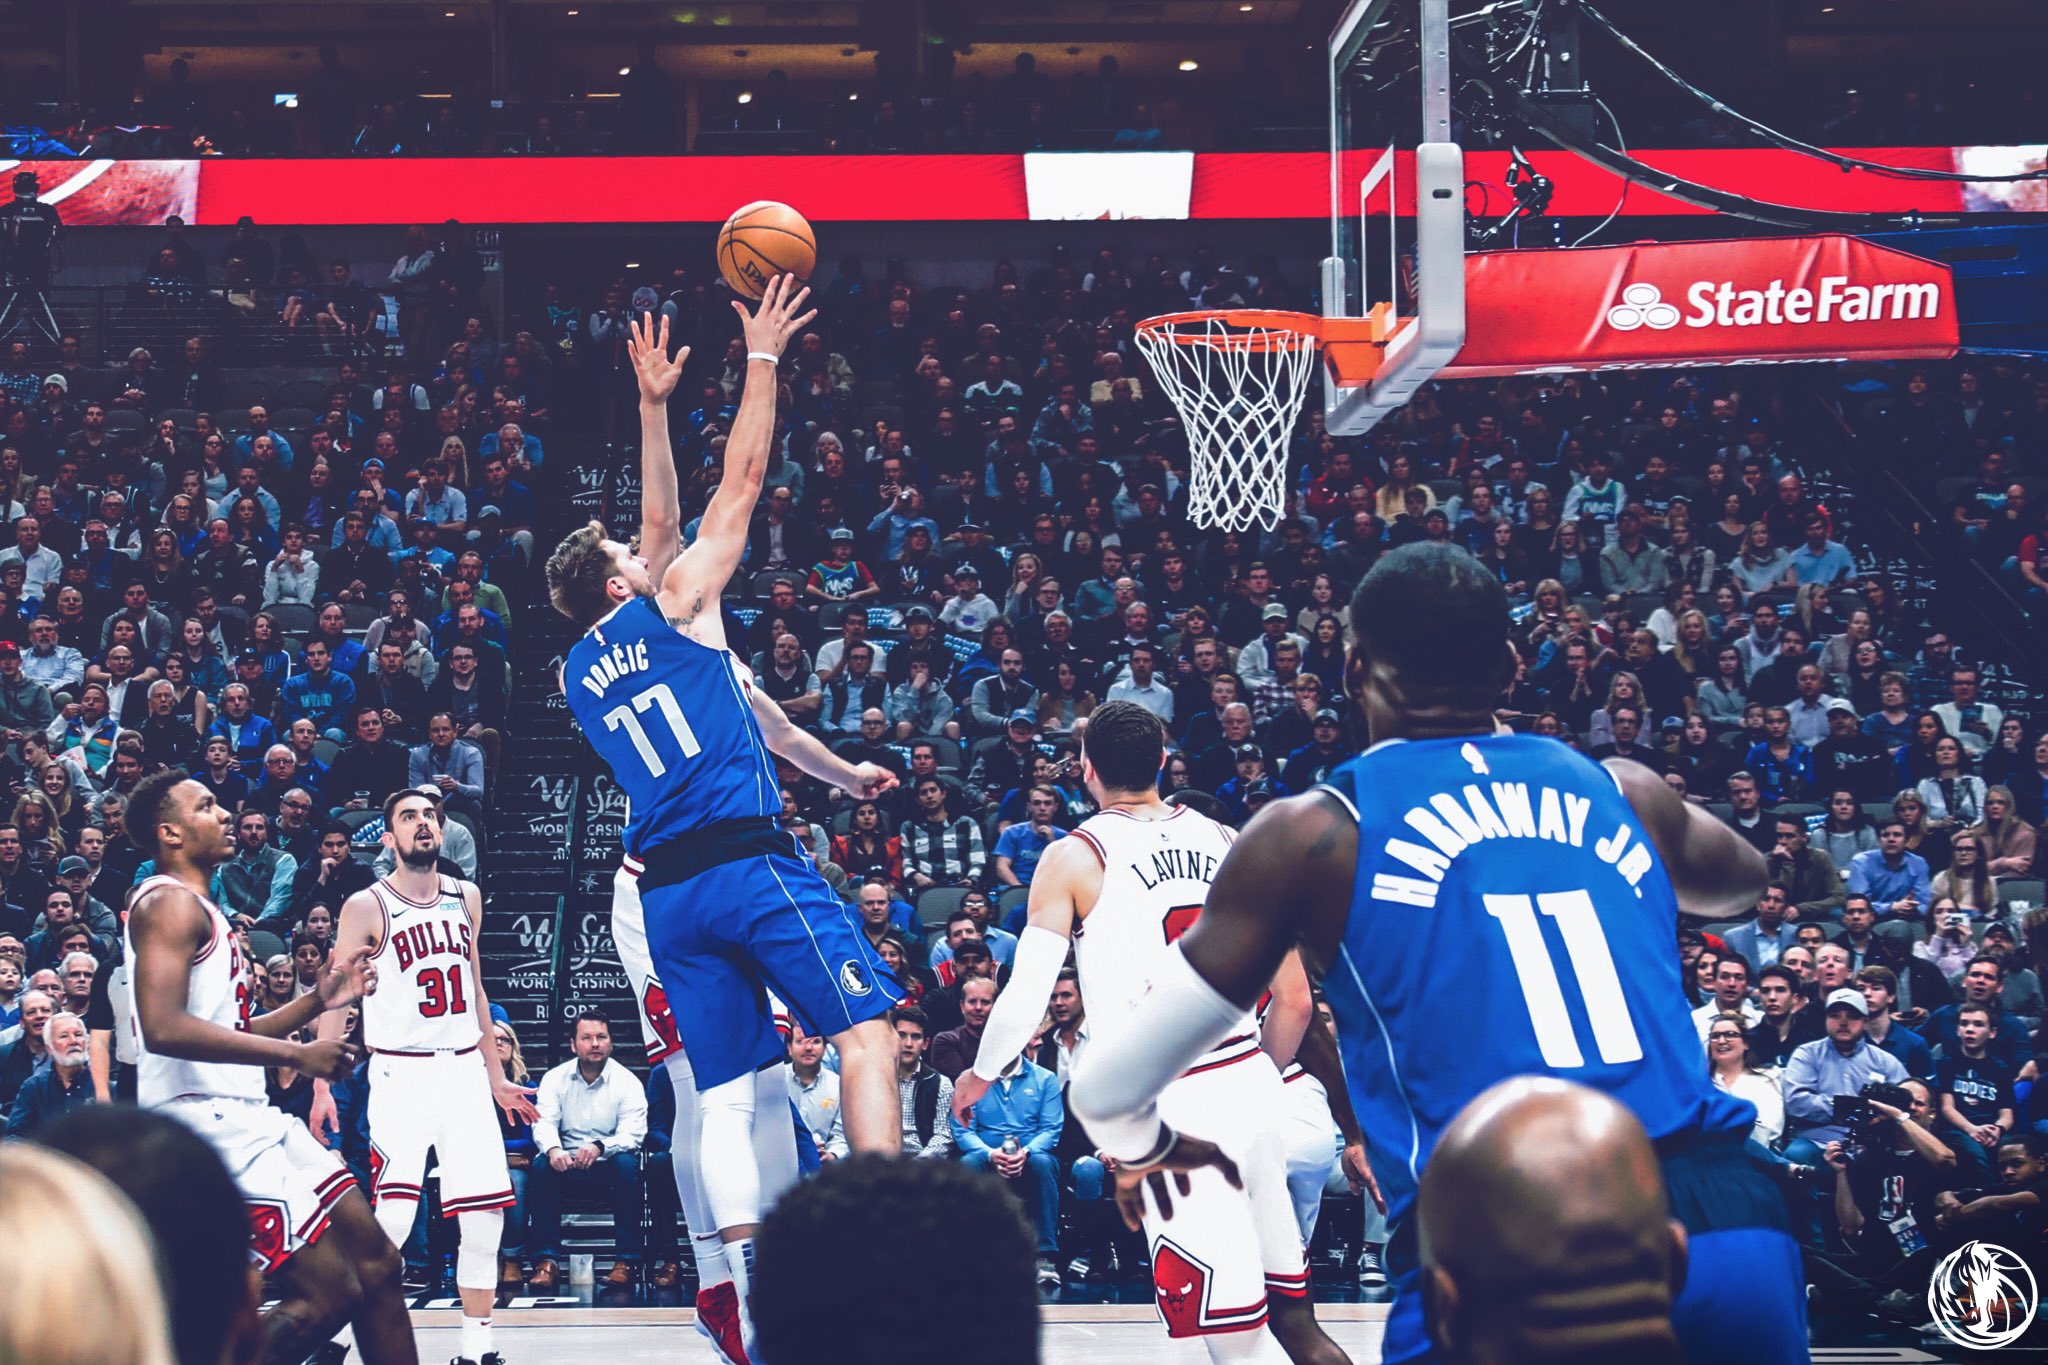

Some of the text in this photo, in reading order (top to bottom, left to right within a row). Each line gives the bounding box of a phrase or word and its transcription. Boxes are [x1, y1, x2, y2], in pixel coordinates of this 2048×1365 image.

[582, 638, 650, 699] DONČIĆ
[603, 683, 702, 778] 77
[1131, 849, 1218, 891] LAVINE
[1371, 782, 1653, 908] HARDAWAY JR.
[392, 920, 473, 973] BULLS
[416, 965, 467, 1019] 31
[1482, 888, 1643, 1069] 11
